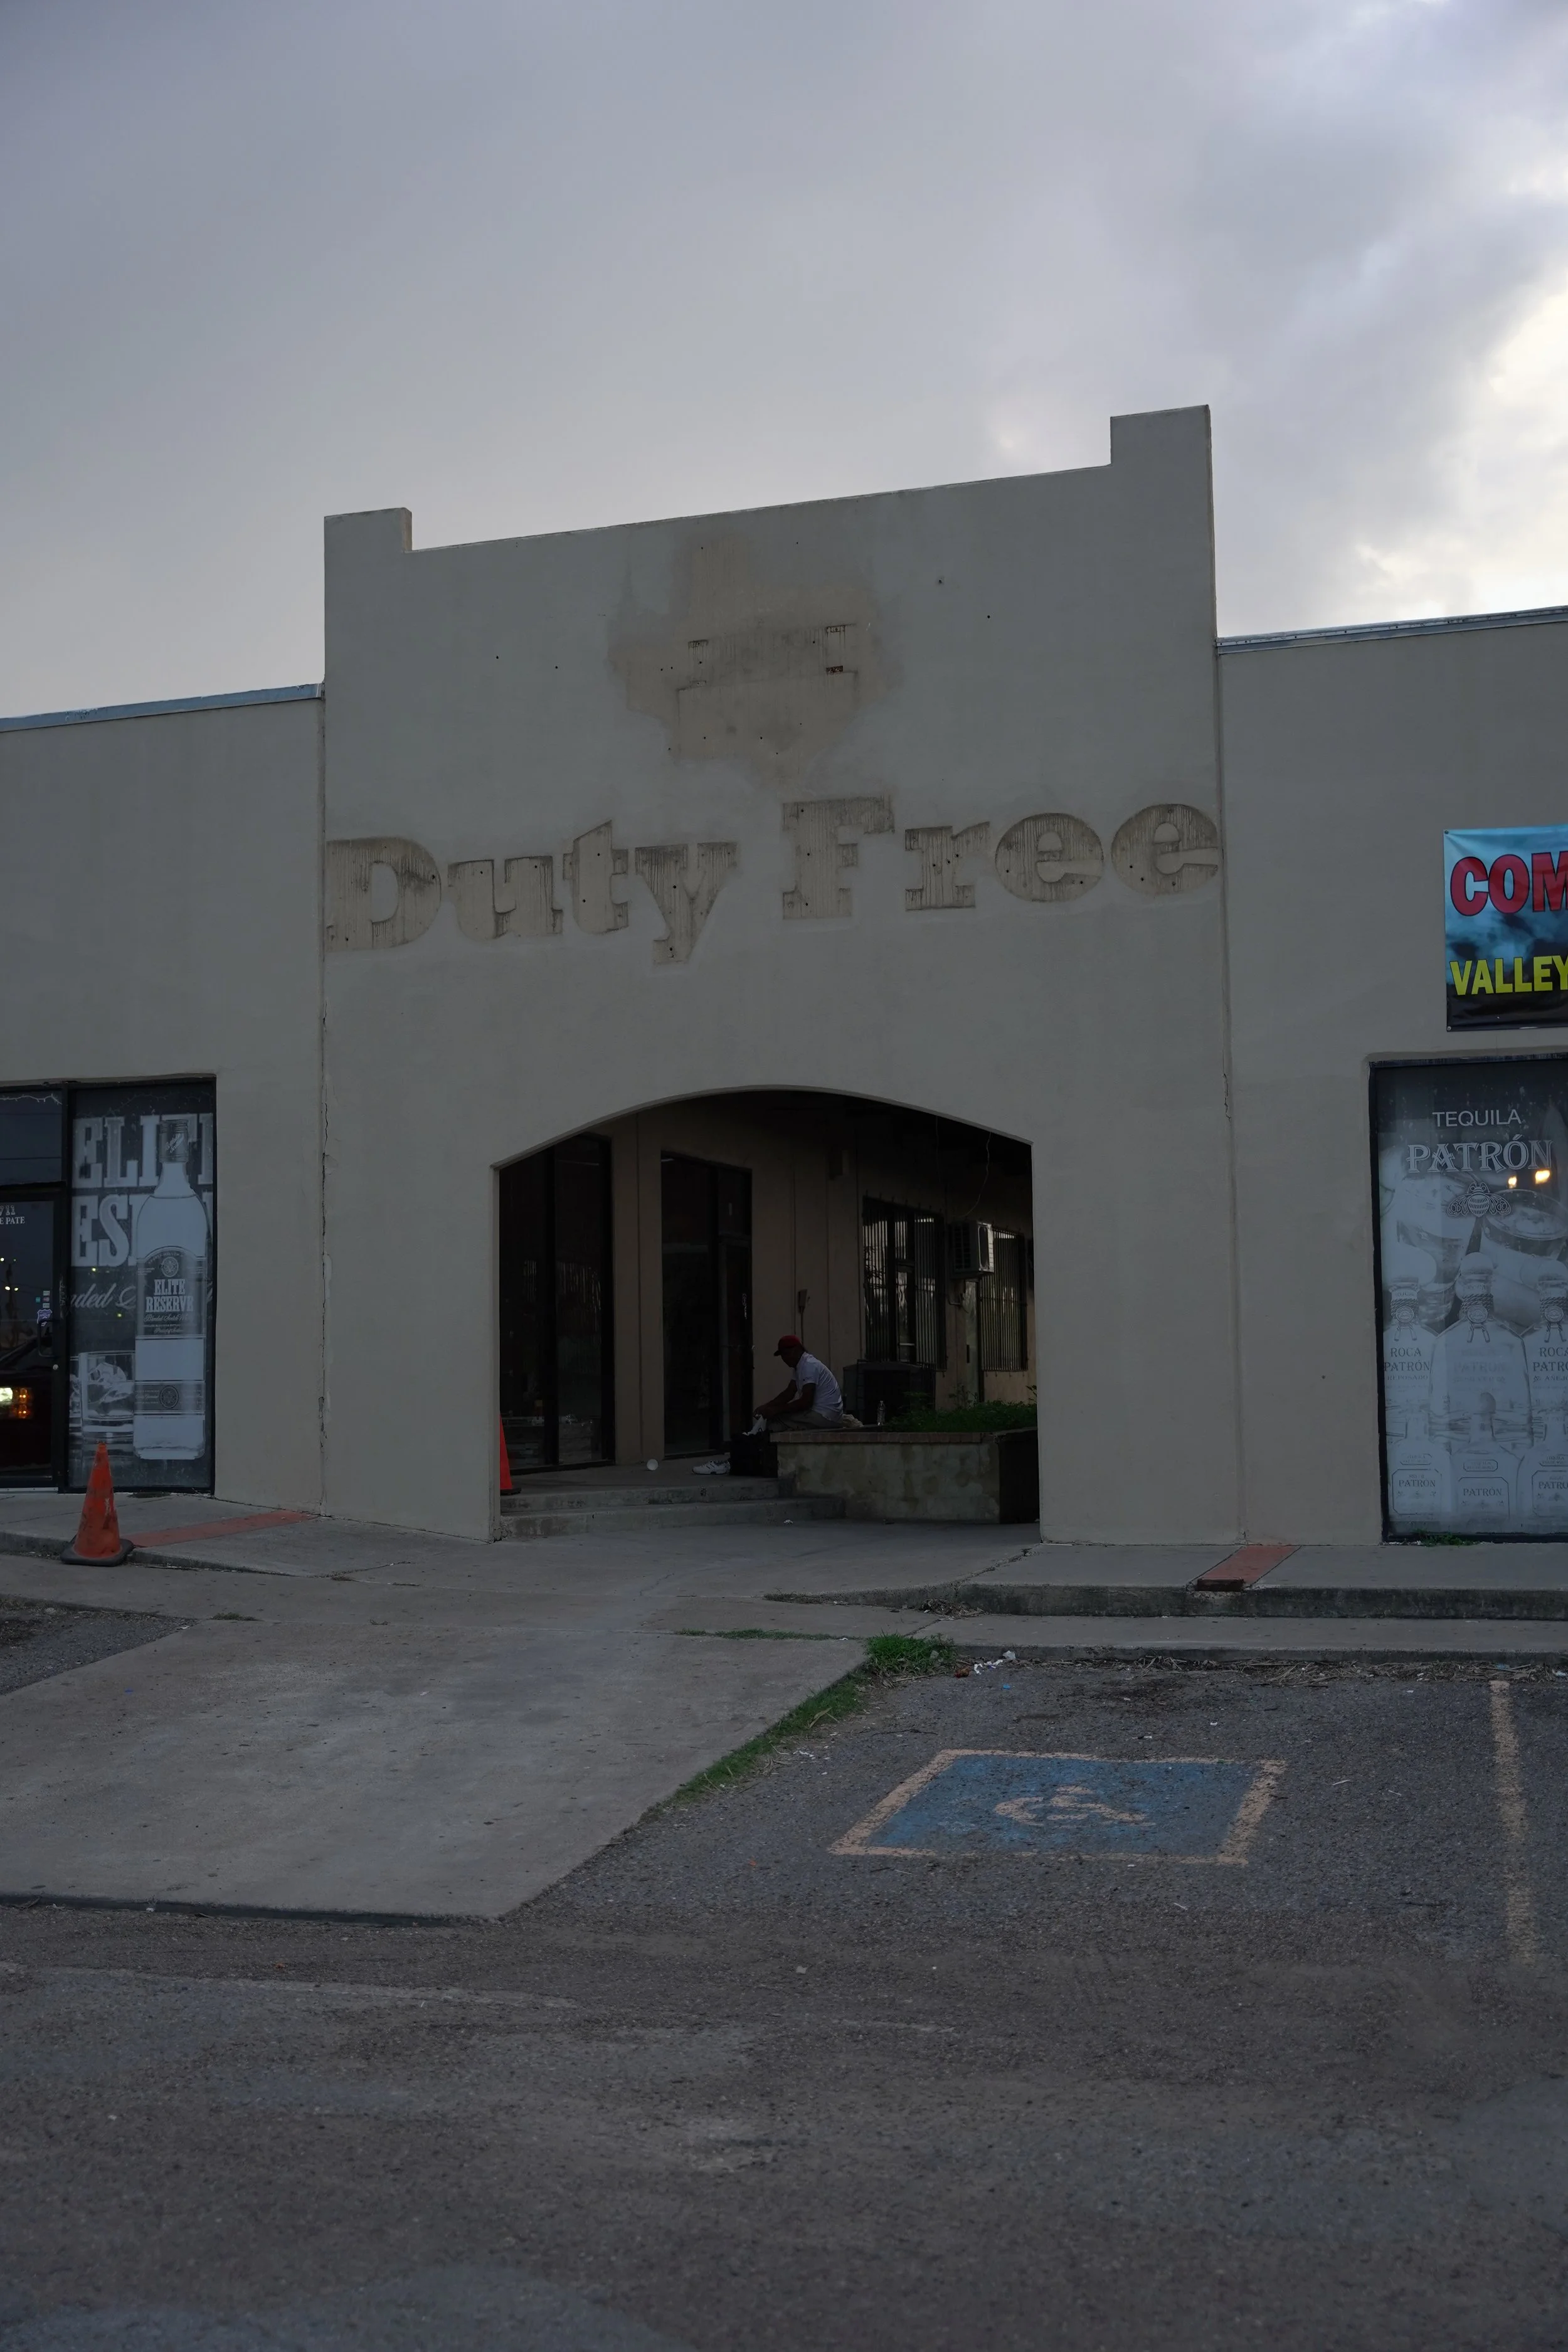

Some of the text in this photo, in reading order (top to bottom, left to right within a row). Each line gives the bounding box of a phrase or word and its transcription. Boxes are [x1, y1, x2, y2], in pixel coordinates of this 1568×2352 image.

[326, 795, 1219, 965] Duty Free
[1449, 955, 1568, 996] VALLEY
[1432, 1109, 1522, 1127] TEQUILA
[1407, 1134, 1554, 1173] PATRÓN
[5, 1216, 26, 1225] PATE
[154, 1279, 186, 1296] ELITE
[146, 1295, 194, 1313] RESERVE
[1390, 1347, 1422, 1357] ROCA
